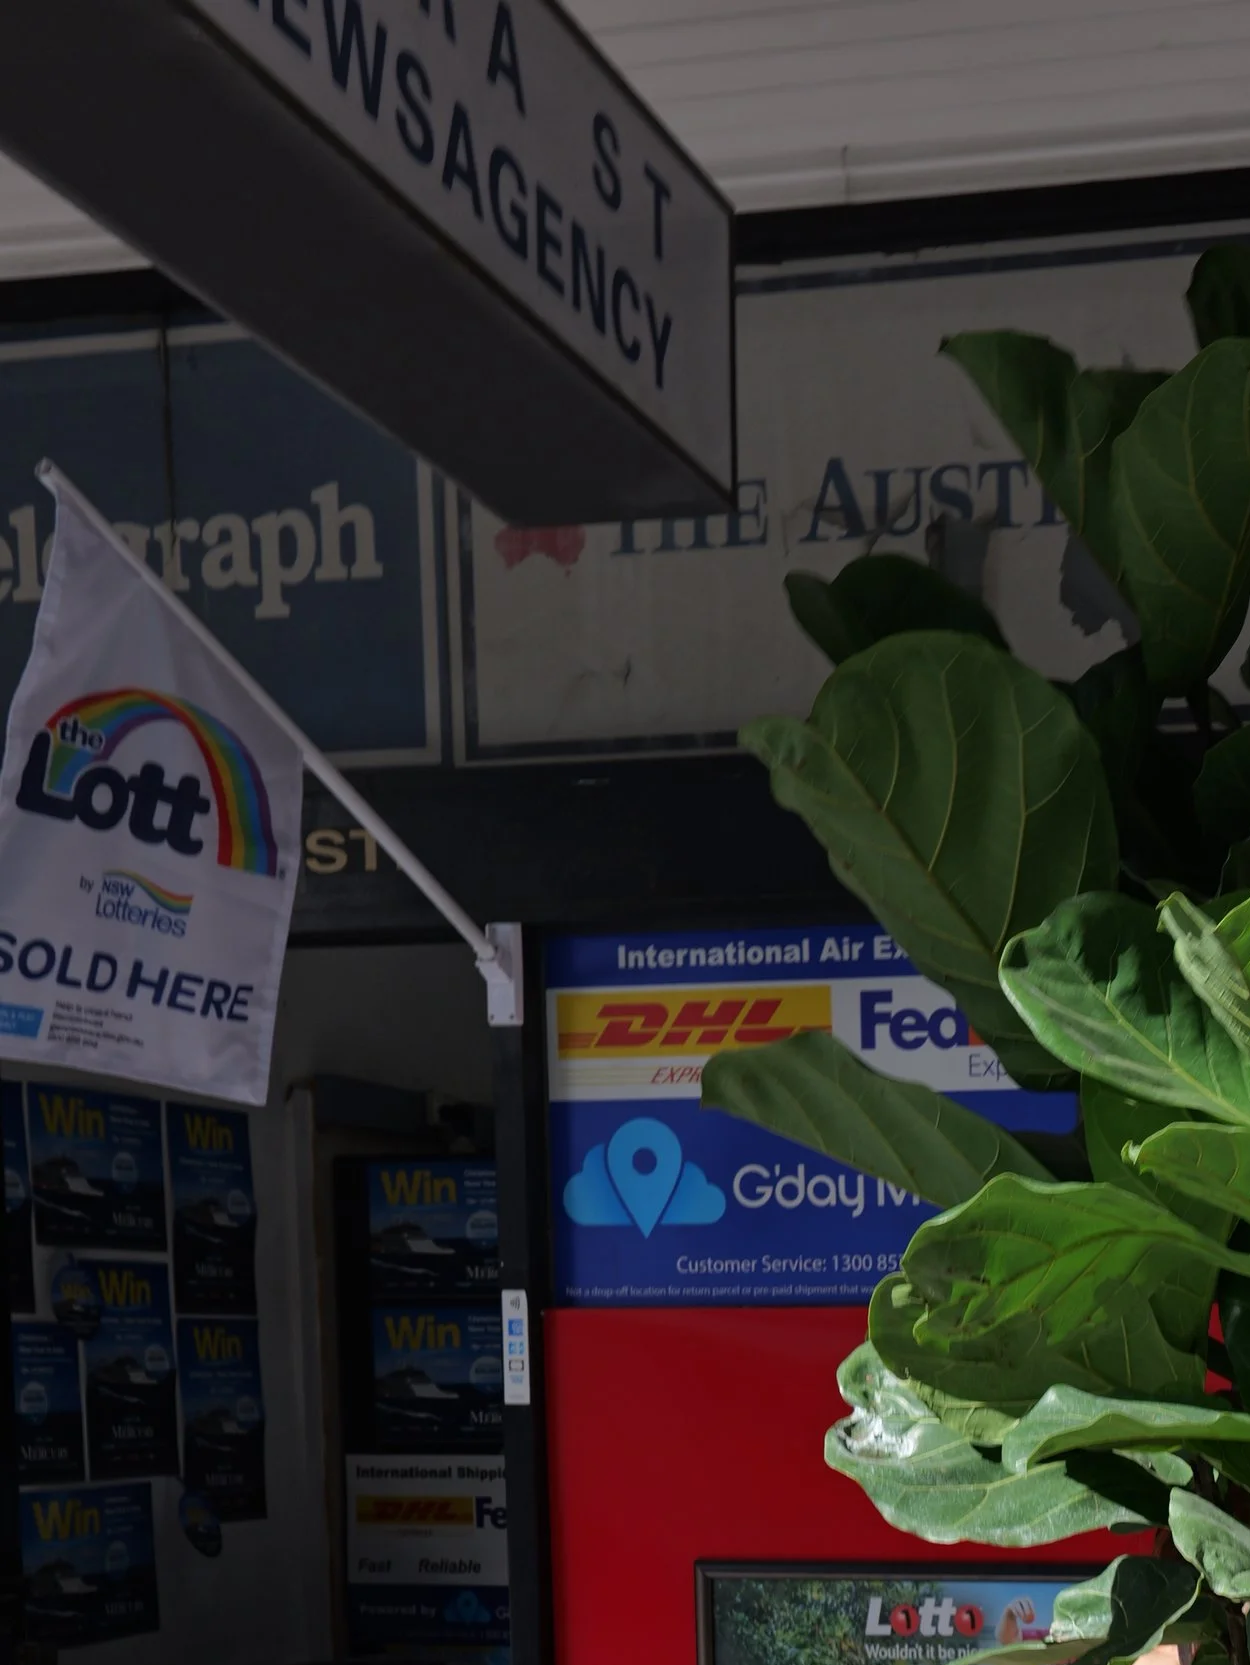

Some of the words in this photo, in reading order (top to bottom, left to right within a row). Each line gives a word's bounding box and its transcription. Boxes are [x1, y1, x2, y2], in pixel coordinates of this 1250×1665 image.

[797, 455, 1065, 545] AUST
[59, 718, 104, 748] the
[16, 731, 211, 856] Lott
[80, 876, 94, 894] by
[101, 880, 135, 898] NSW
[95, 892, 188, 938] Lotteries
[617, 937, 810, 970] International
[819, 936, 865, 963] Air
[125, 958, 253, 1021] HERE
[594, 998, 783, 1048] DHL
[860, 988, 985, 1050] Fed
[38, 1093, 106, 1143] Win
[184, 1111, 235, 1152] Win
[381, 1168, 458, 1206] Win
[732, 1162, 865, 1218] G'day
[676, 1254, 758, 1275] Customer
[762, 1253, 827, 1274] Service:
[832, 1252, 873, 1273] 1300
[98, 1267, 151, 1308] Win
[193, 1325, 244, 1366] Win
[384, 1313, 461, 1351] Win
[356, 1465, 452, 1479] International
[32, 1499, 100, 1543] Win
[372, 1500, 458, 1521] DHL
[358, 1557, 392, 1574] Fast
[418, 1557, 482, 1574] Reliable
[864, 1643, 924, 1660] Wouldn't
[926, 1644, 935, 1660] it
[938, 1644, 956, 1660] be
